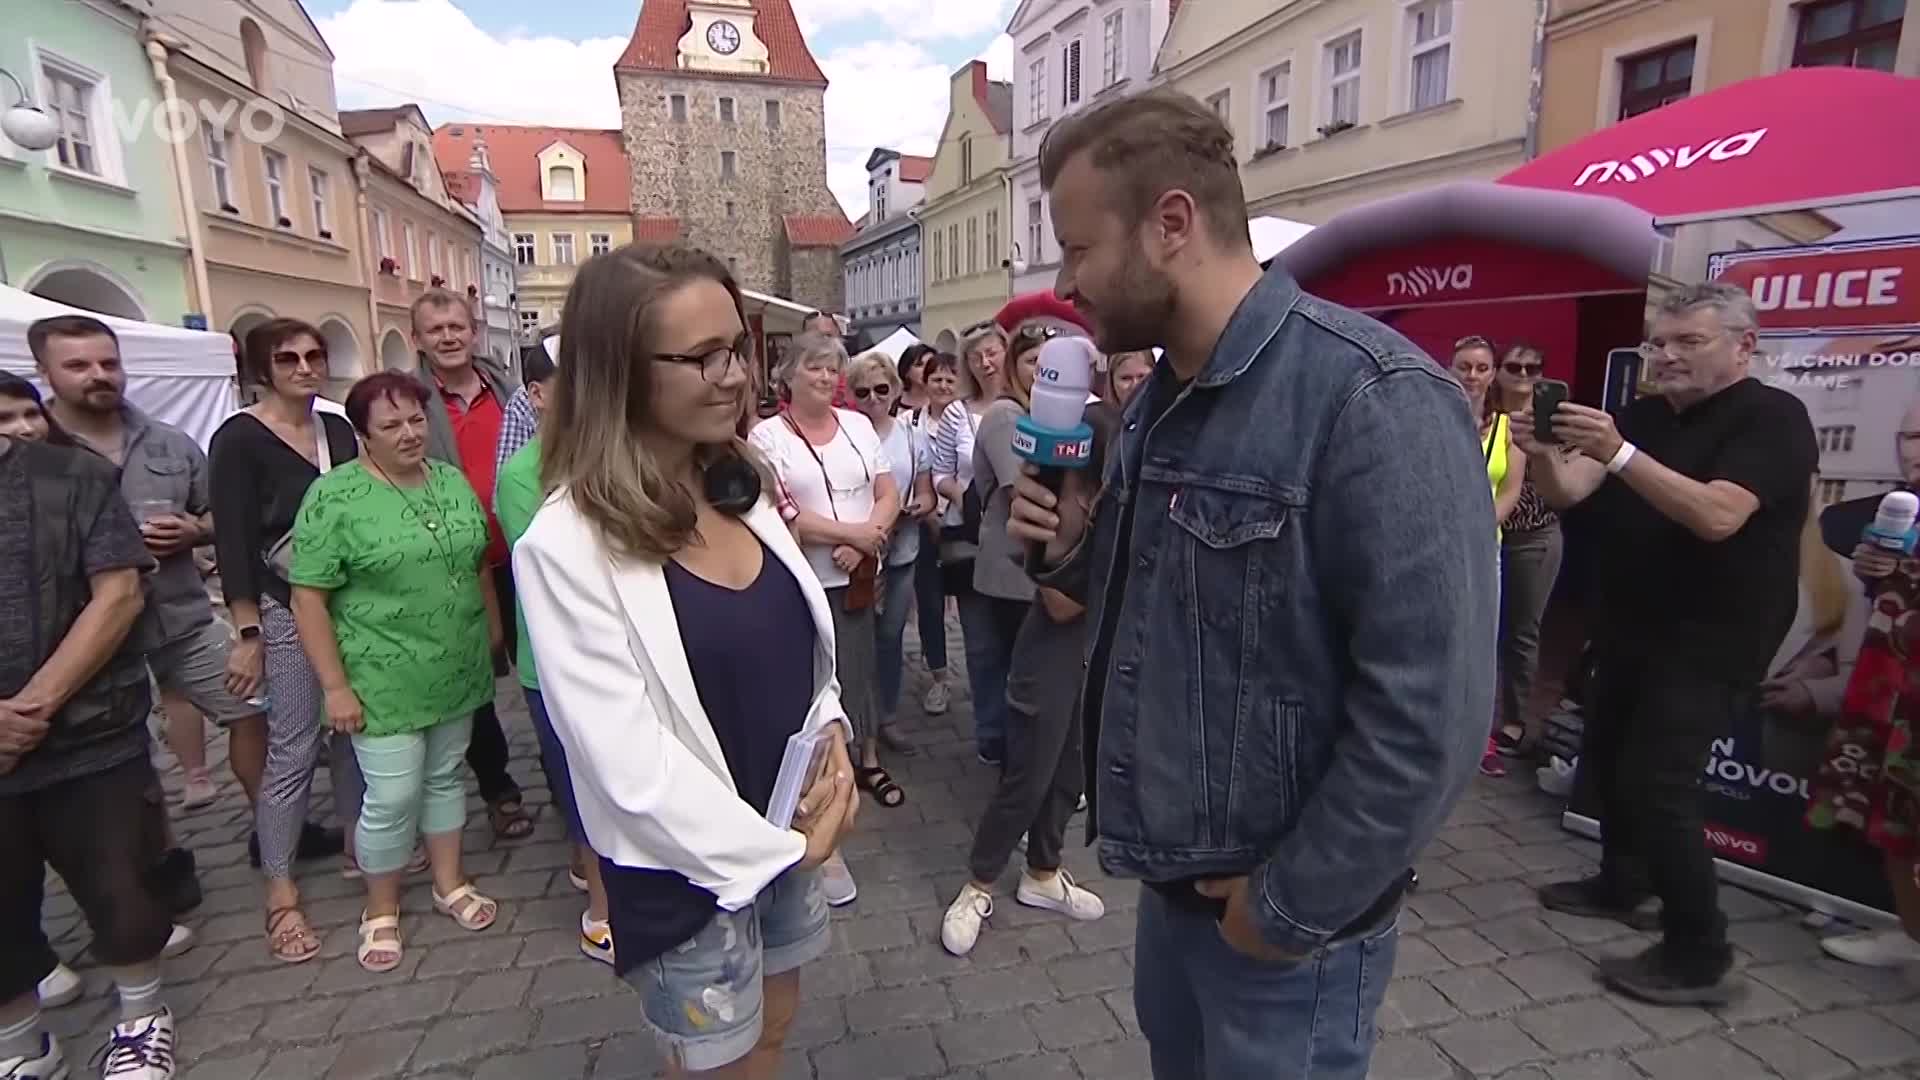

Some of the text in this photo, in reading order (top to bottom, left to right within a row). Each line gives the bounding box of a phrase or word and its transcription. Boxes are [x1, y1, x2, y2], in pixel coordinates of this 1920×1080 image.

[1573, 128, 1768, 186] nova
[1387, 264, 1473, 297] nova
[1752, 267, 1903, 311] ULICE
[1056, 444, 1076, 456] TN
